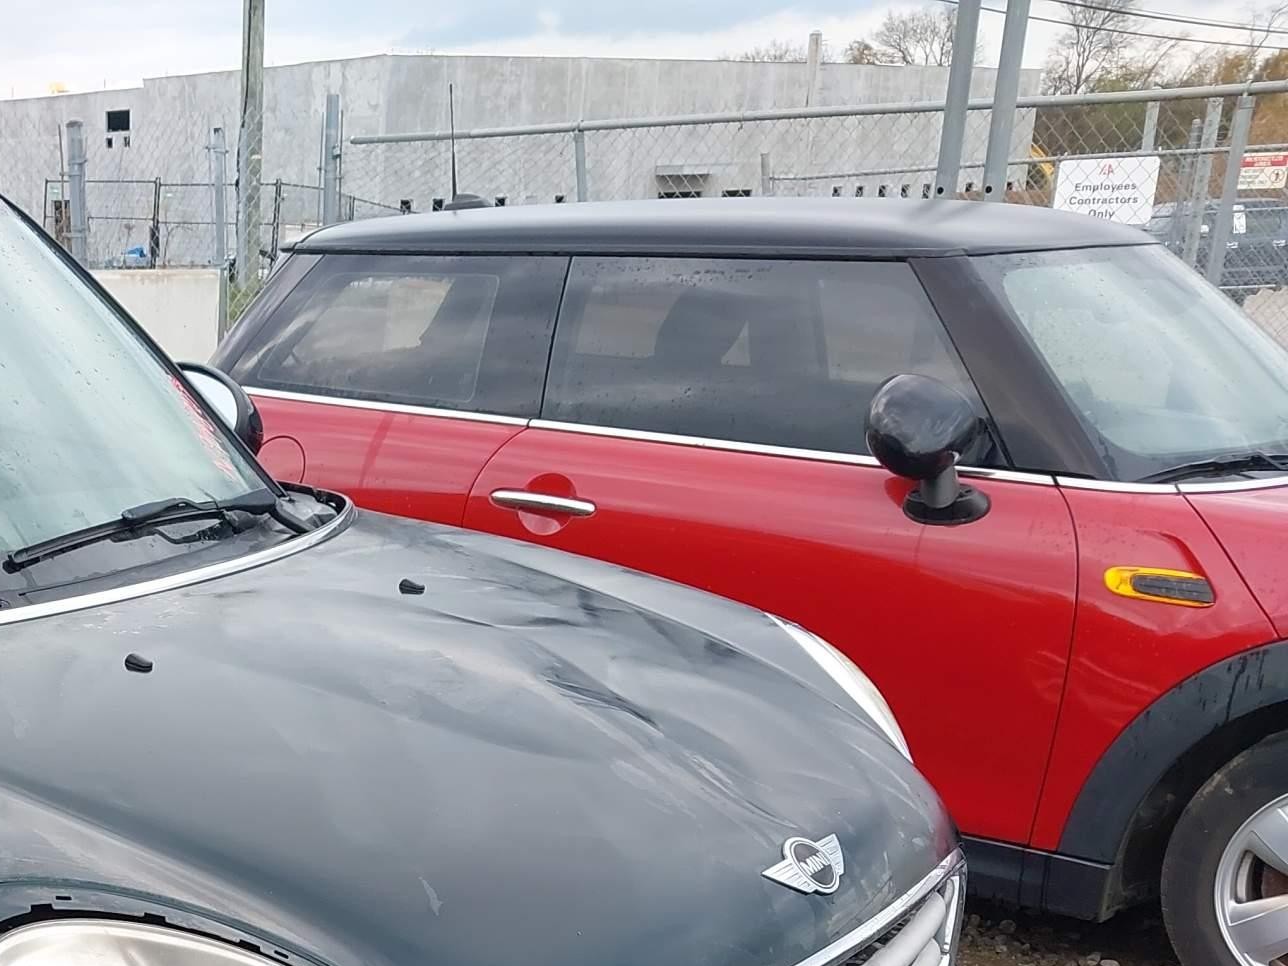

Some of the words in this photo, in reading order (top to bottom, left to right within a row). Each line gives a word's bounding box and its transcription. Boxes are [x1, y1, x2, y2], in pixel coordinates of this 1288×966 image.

[1075, 182, 1137, 192] Employees
[1069, 196, 1138, 206] Contractors
[1088, 209, 1115, 219] Only
